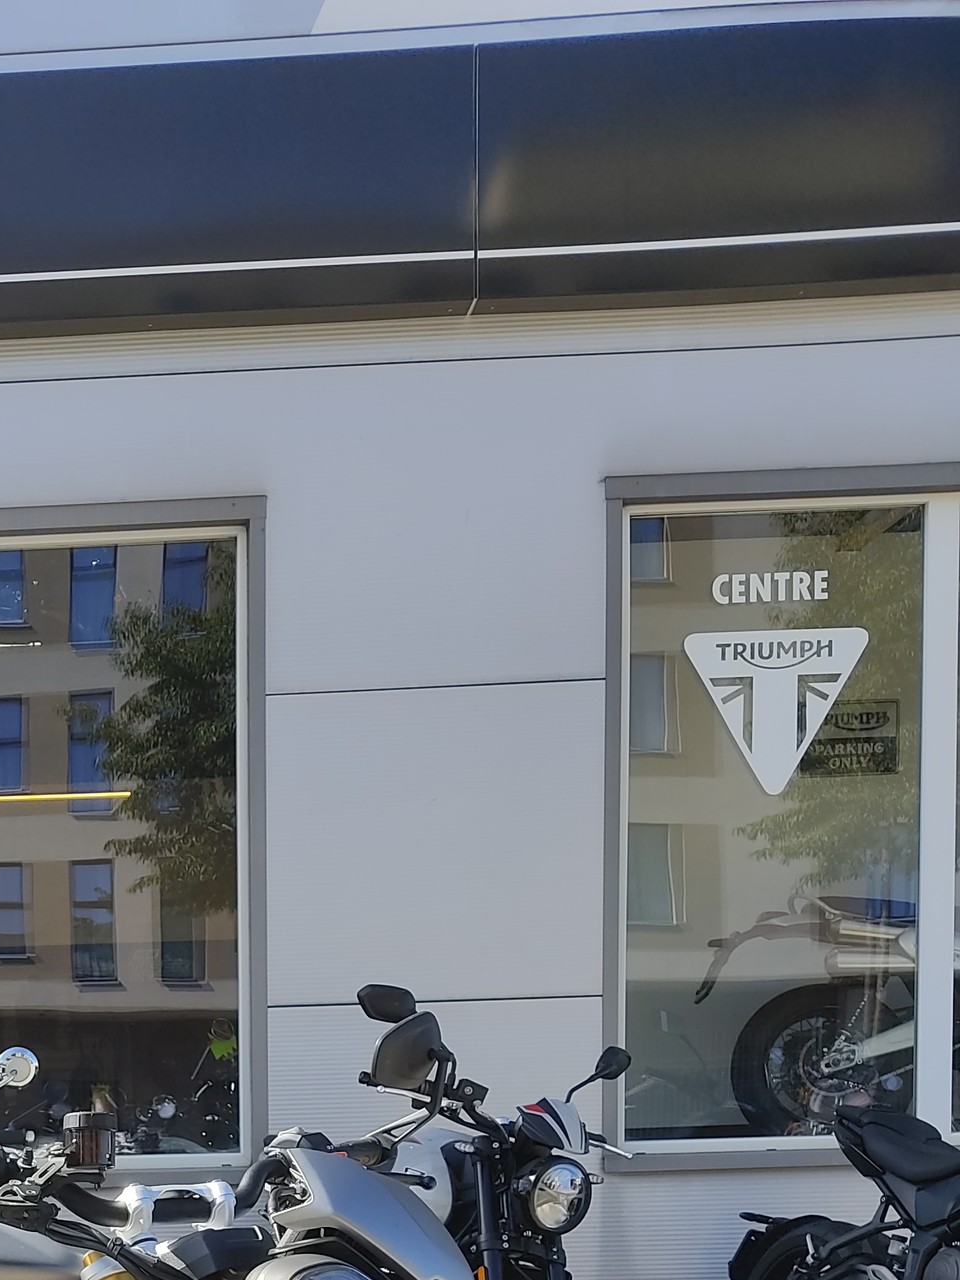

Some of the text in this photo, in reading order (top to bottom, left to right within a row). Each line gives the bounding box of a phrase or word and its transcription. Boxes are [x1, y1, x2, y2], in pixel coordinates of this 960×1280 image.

[712, 570, 829, 605] CENTRE
[716, 640, 833, 668] TRIUMPH
[823, 712, 890, 731] RIUMPH
[815, 742, 885, 756] PARKING
[829, 756, 870, 769] ONLY
